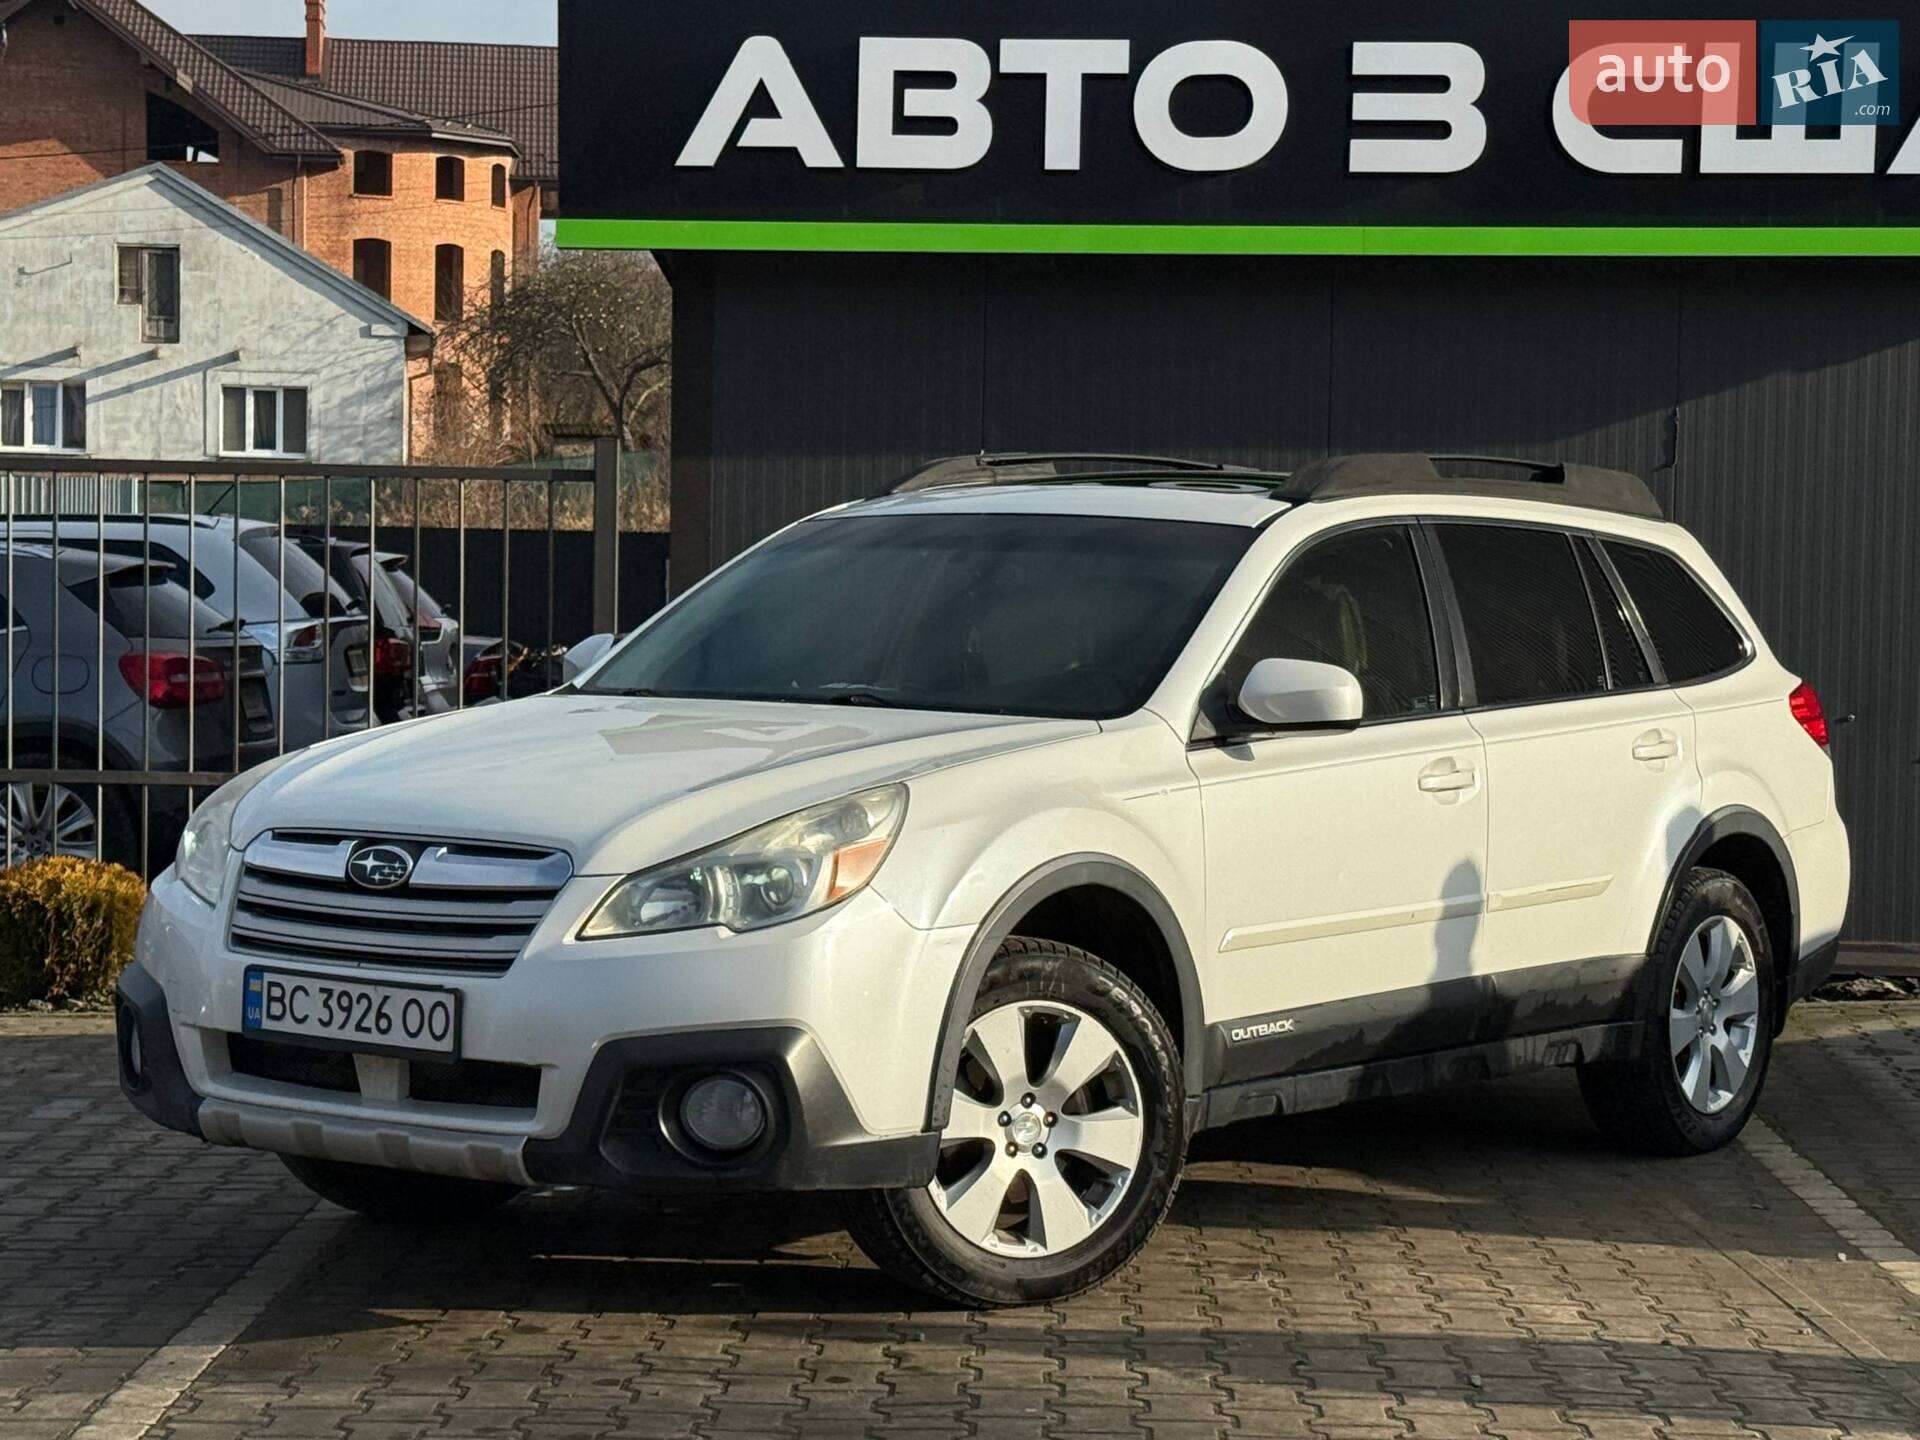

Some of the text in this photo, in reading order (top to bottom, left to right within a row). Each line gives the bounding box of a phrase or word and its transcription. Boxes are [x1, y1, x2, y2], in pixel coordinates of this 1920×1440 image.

[675, 35, 1920, 175] АВТО З СШ
[317, 986, 393, 1036] 3926
[1231, 1018, 1295, 1041] OUTBACK
